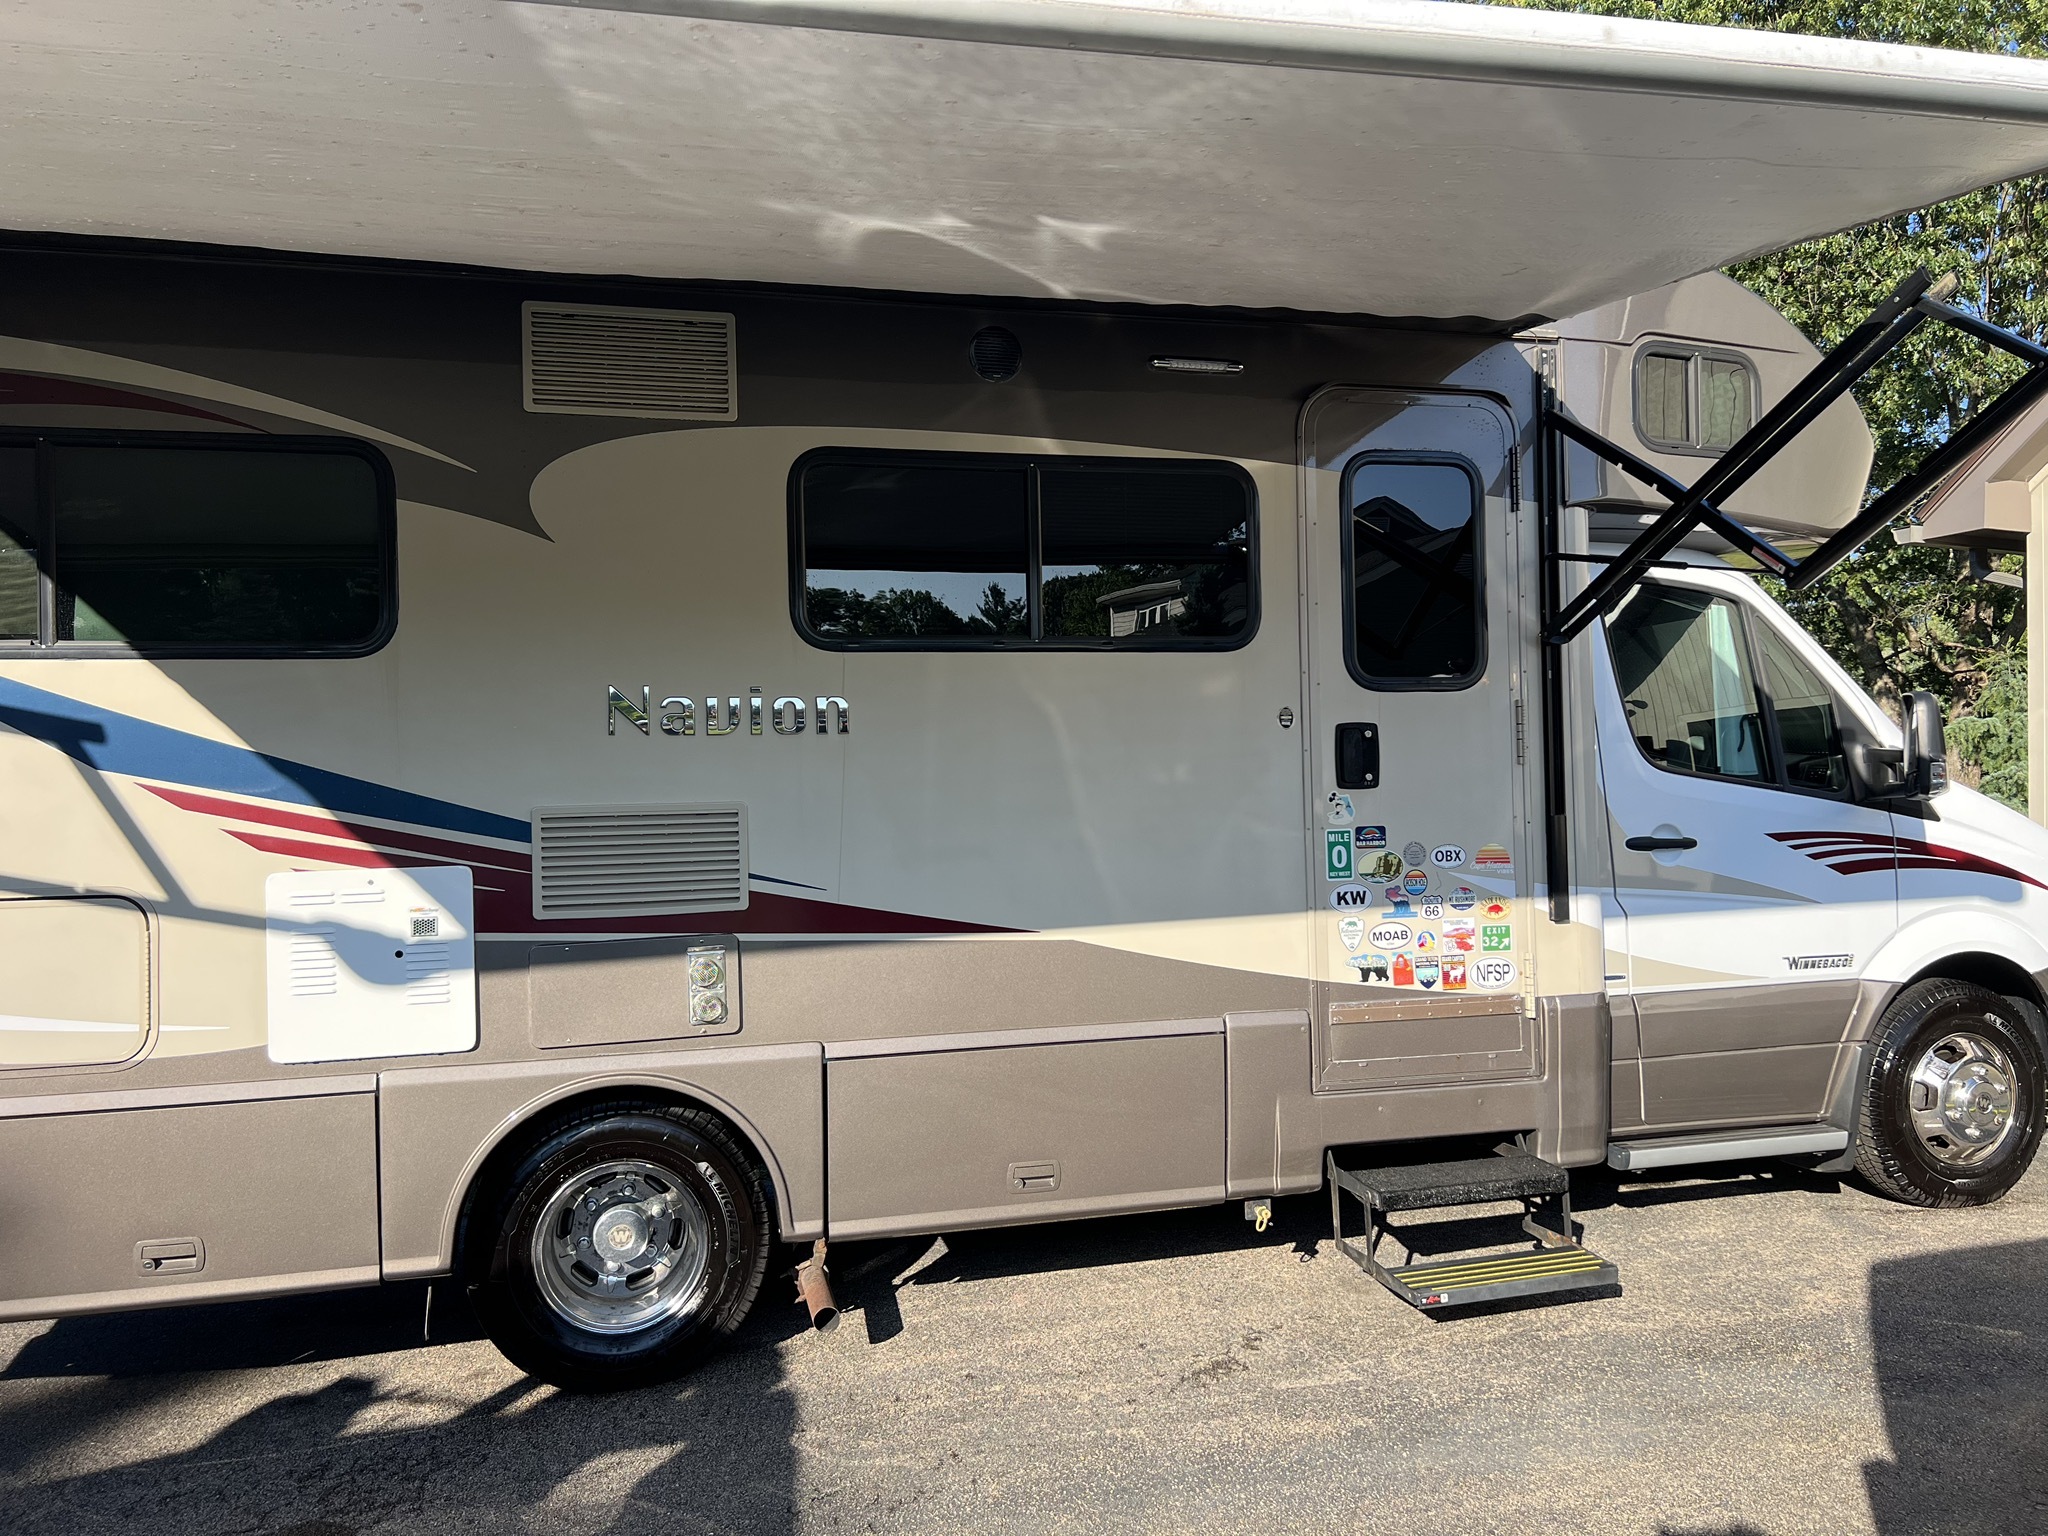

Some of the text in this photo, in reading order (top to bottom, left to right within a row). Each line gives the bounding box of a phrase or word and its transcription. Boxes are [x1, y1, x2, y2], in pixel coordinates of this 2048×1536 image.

[608, 684, 850, 736] Navion
[1328, 833, 1350, 842] MILE
[1332, 845, 1347, 869] 0
[1435, 850, 1462, 862] OBX
[1336, 890, 1367, 905] KW
[1425, 905, 1439, 917] 66
[1372, 930, 1408, 942] MOAB
[1486, 927, 1506, 935] EXIT
[1482, 936, 1498, 947] 32
[1782, 954, 1849, 970] WINNEBAGO
[1476, 963, 1510, 982] NFSP
[711, 1181, 739, 1257] MICHELIN
